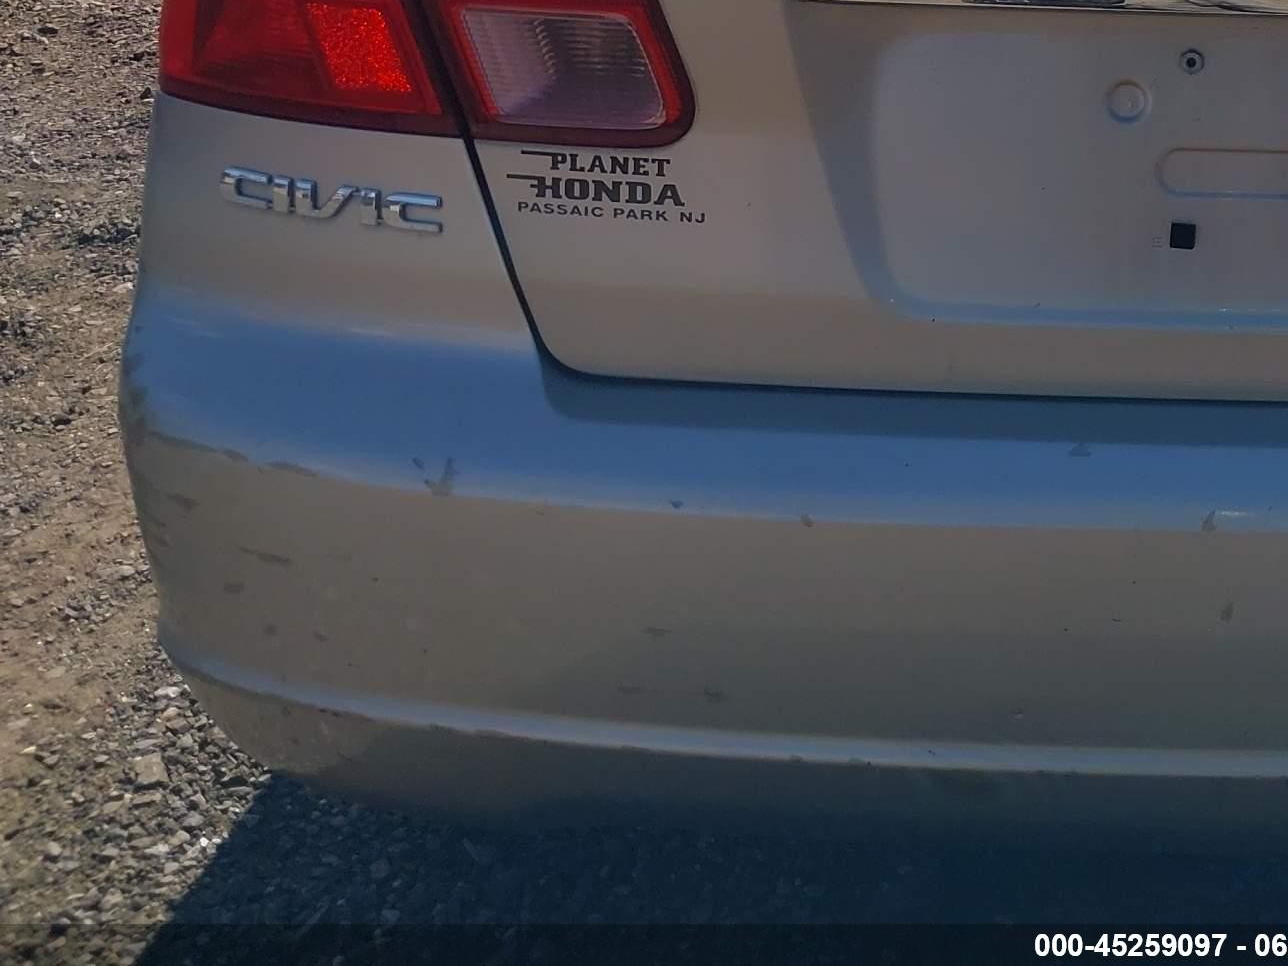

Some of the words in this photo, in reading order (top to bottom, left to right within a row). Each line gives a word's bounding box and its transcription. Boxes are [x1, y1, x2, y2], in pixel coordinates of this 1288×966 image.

[521, 150, 671, 177] PLANET
[221, 166, 443, 233] CIVIC
[507, 174, 685, 206] HONDA
[517, 201, 605, 218] PASSAIC
[613, 207, 669, 222] PARK
[680, 211, 706, 224] NJ
